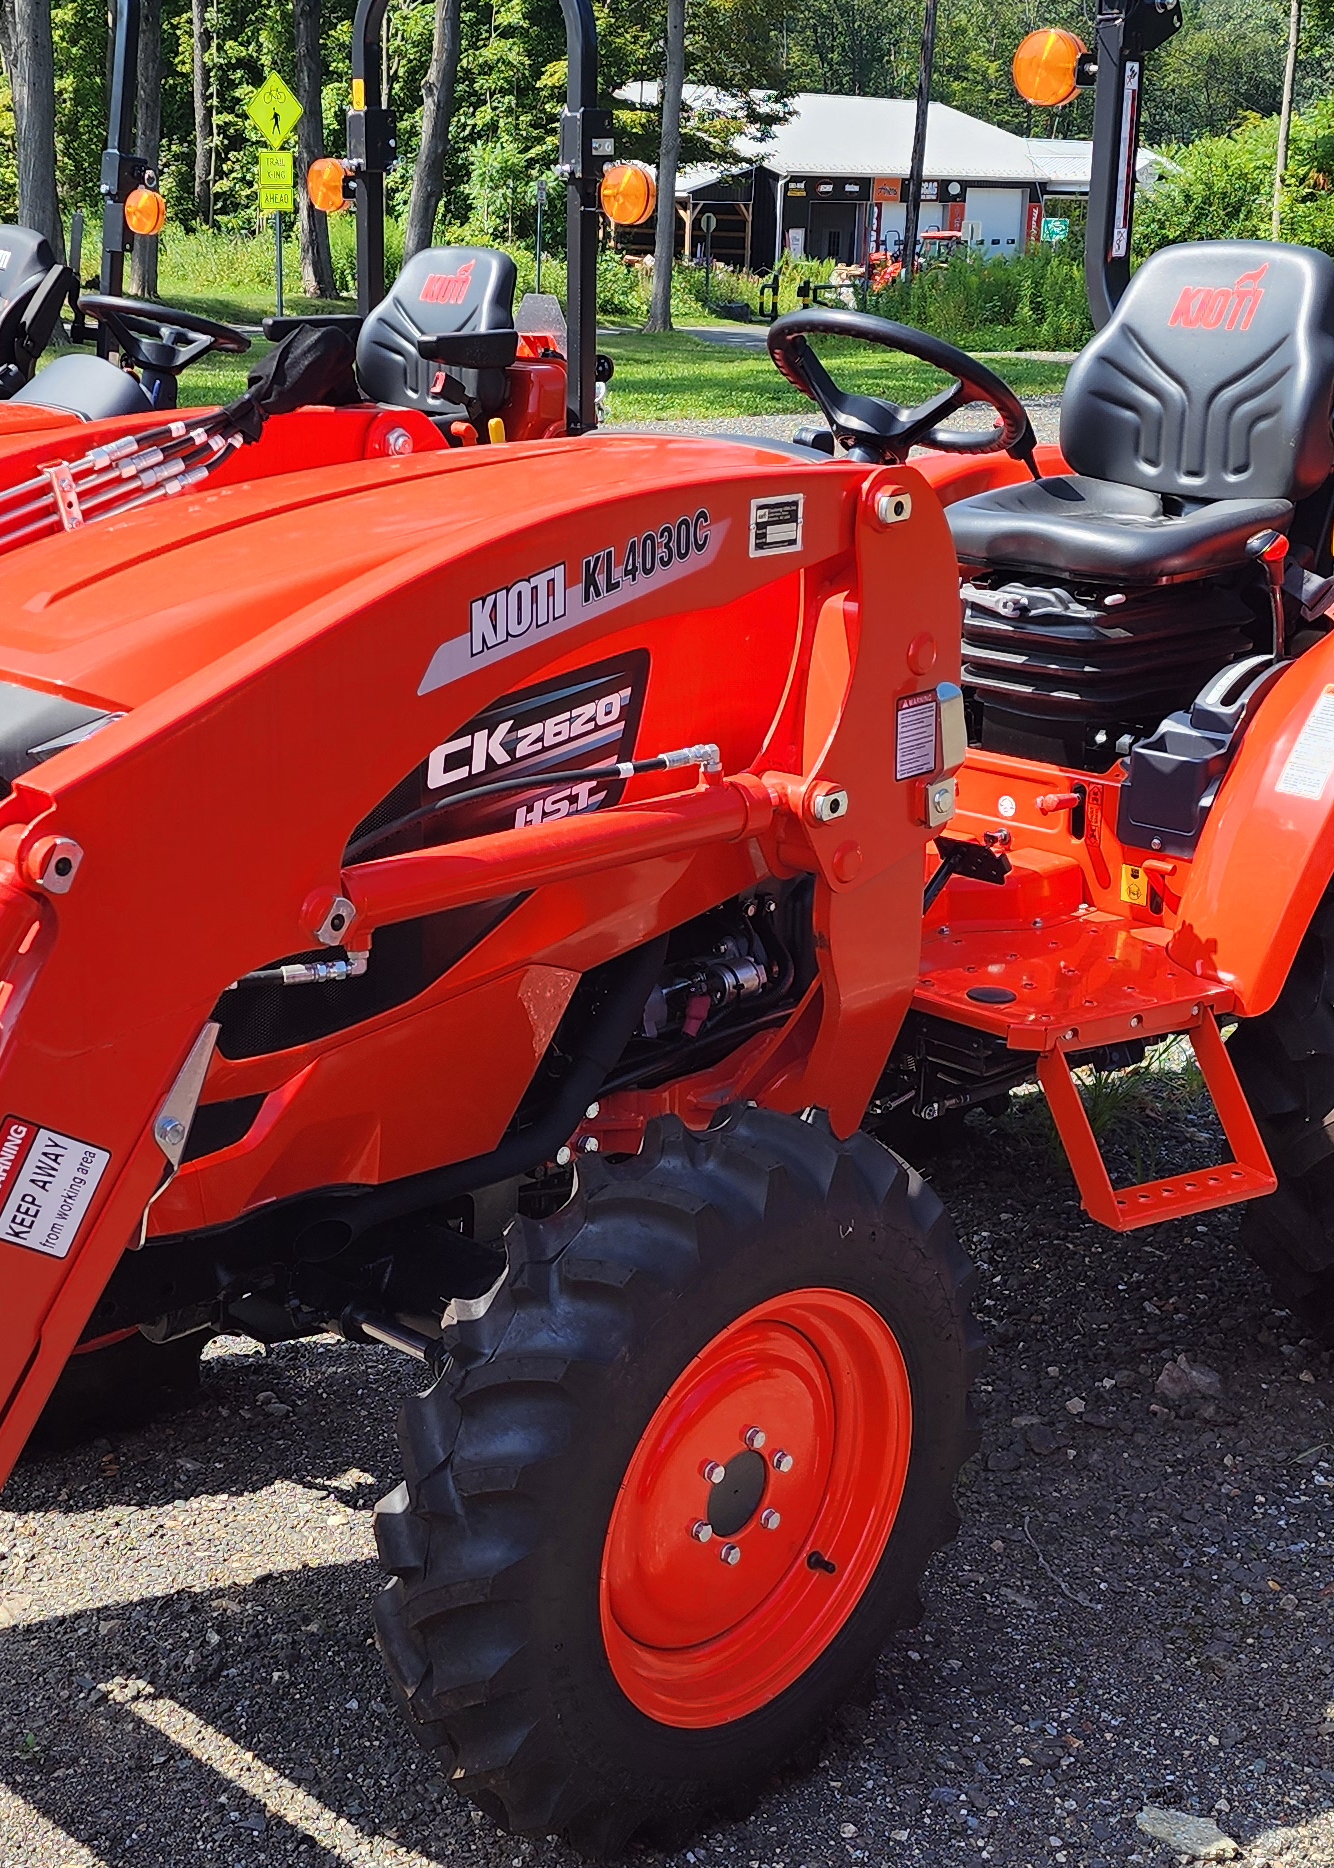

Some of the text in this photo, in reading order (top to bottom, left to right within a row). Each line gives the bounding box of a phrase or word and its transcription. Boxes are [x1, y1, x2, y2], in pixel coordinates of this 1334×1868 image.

[266, 158, 285, 166] TRAIL
[264, 194, 288, 204] AHEAD
[419, 273, 471, 304] KIOTI
[1167, 285, 1265, 331] KIOTI
[470, 561, 566, 658] KIOTI
[581, 507, 711, 607] KL4030C
[5, 1136, 69, 1241] KEEP AWAY
[39, 1150, 97, 1249] from working area
